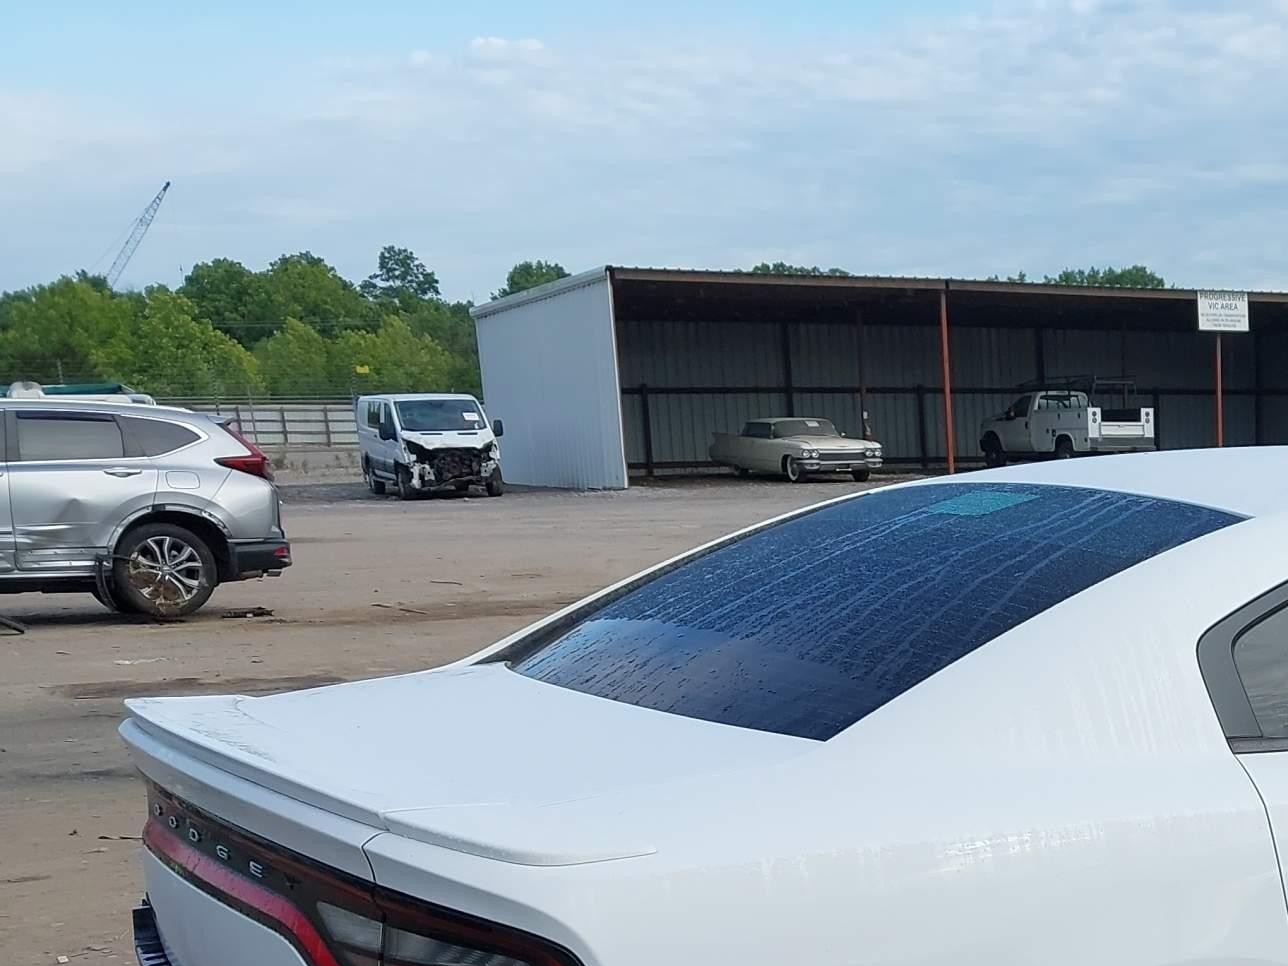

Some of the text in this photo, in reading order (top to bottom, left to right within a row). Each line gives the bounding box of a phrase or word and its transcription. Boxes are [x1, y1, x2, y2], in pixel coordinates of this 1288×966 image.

[1199, 291, 1246, 302] PROGRESSIVE
[1208, 302, 1239, 312] VIC AREA
[153, 803, 264, 878] DODGE
